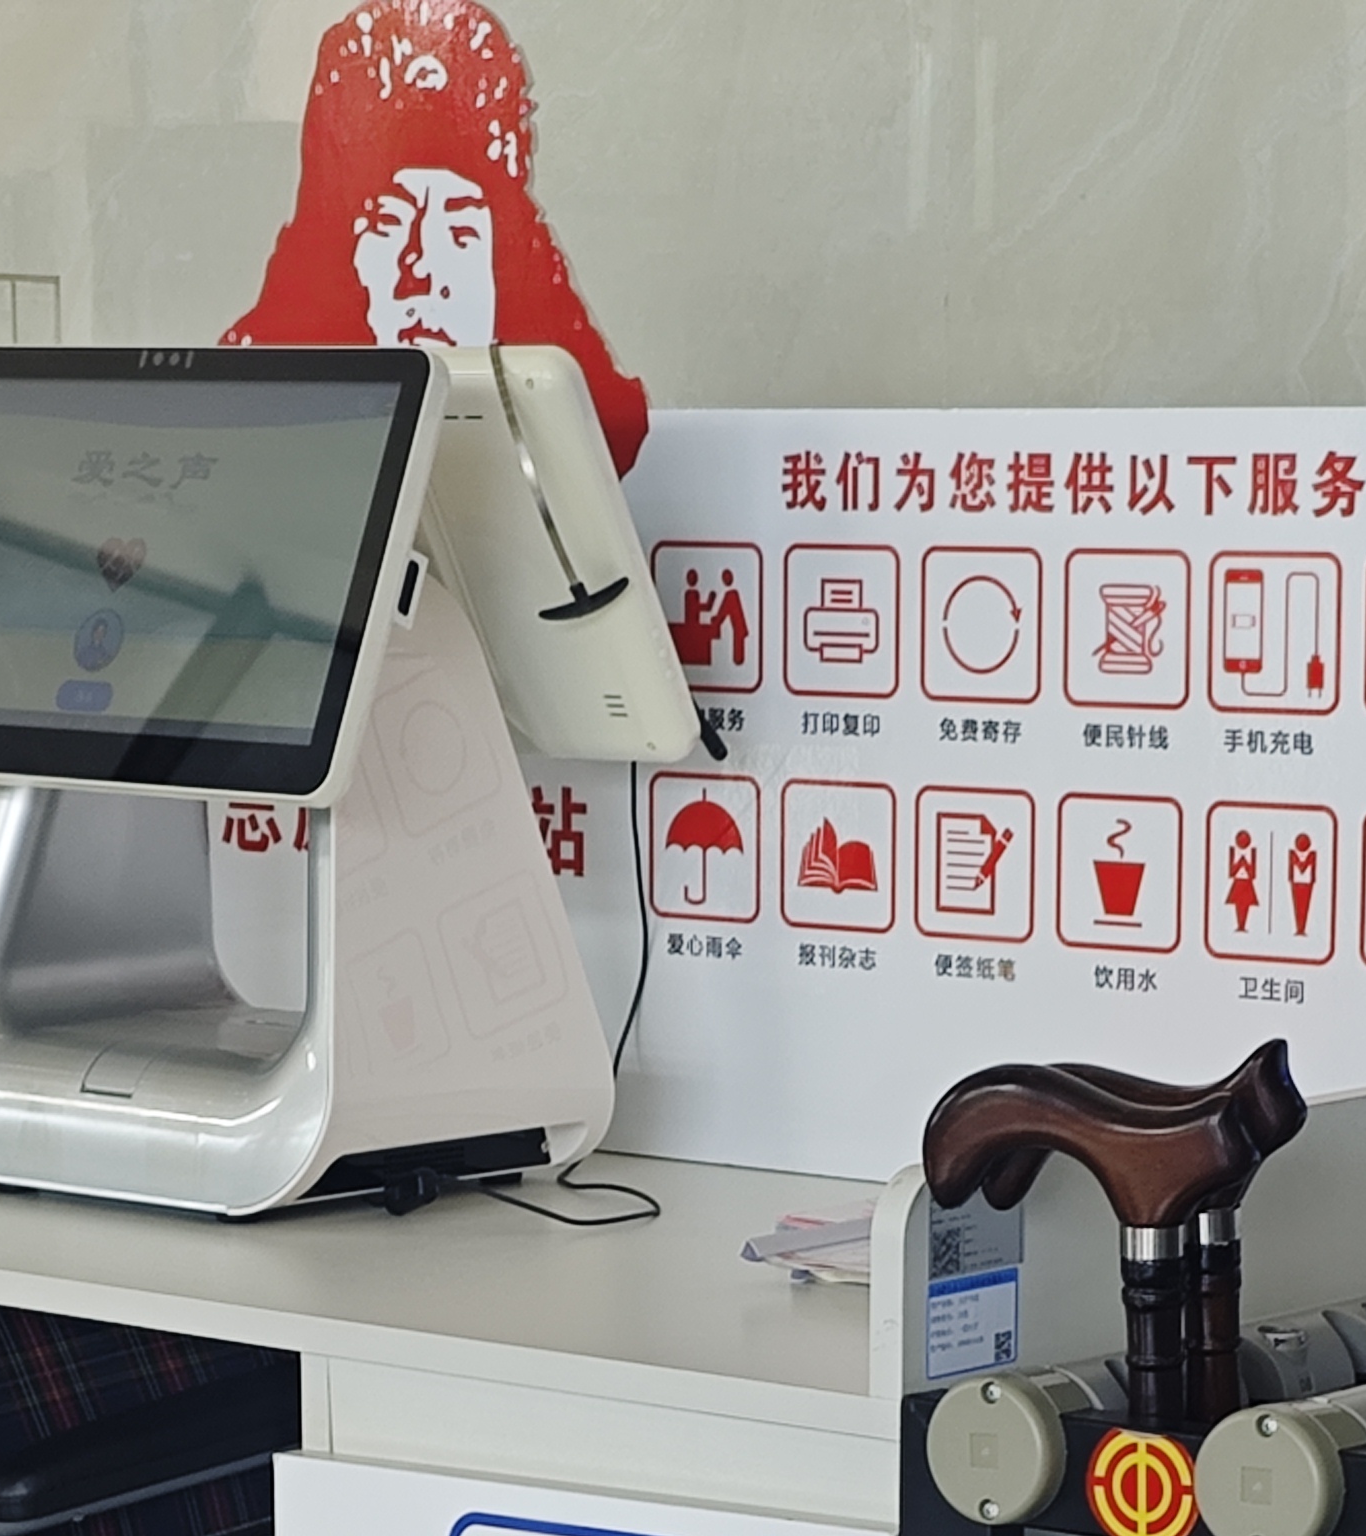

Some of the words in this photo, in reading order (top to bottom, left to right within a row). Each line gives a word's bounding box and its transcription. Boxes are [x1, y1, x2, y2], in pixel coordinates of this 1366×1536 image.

[71, 450, 219, 490] 爱之声
[781, 450, 1366, 518] 我们为您提供以下服务
[698, 707, 745, 732] 服务
[800, 711, 882, 738] 打印复印
[938, 717, 1022, 745] 免费寄存
[1082, 723, 1170, 751] 便民针线
[1222, 729, 1314, 757] 手机充电
[666, 933, 743, 961] 爱心雨伞
[798, 943, 877, 971] 报刊杂志
[934, 953, 1017, 983] 便签纸笔
[1094, 965, 1159, 993] 饮用水
[1237, 976, 1306, 1005] 卫生间
